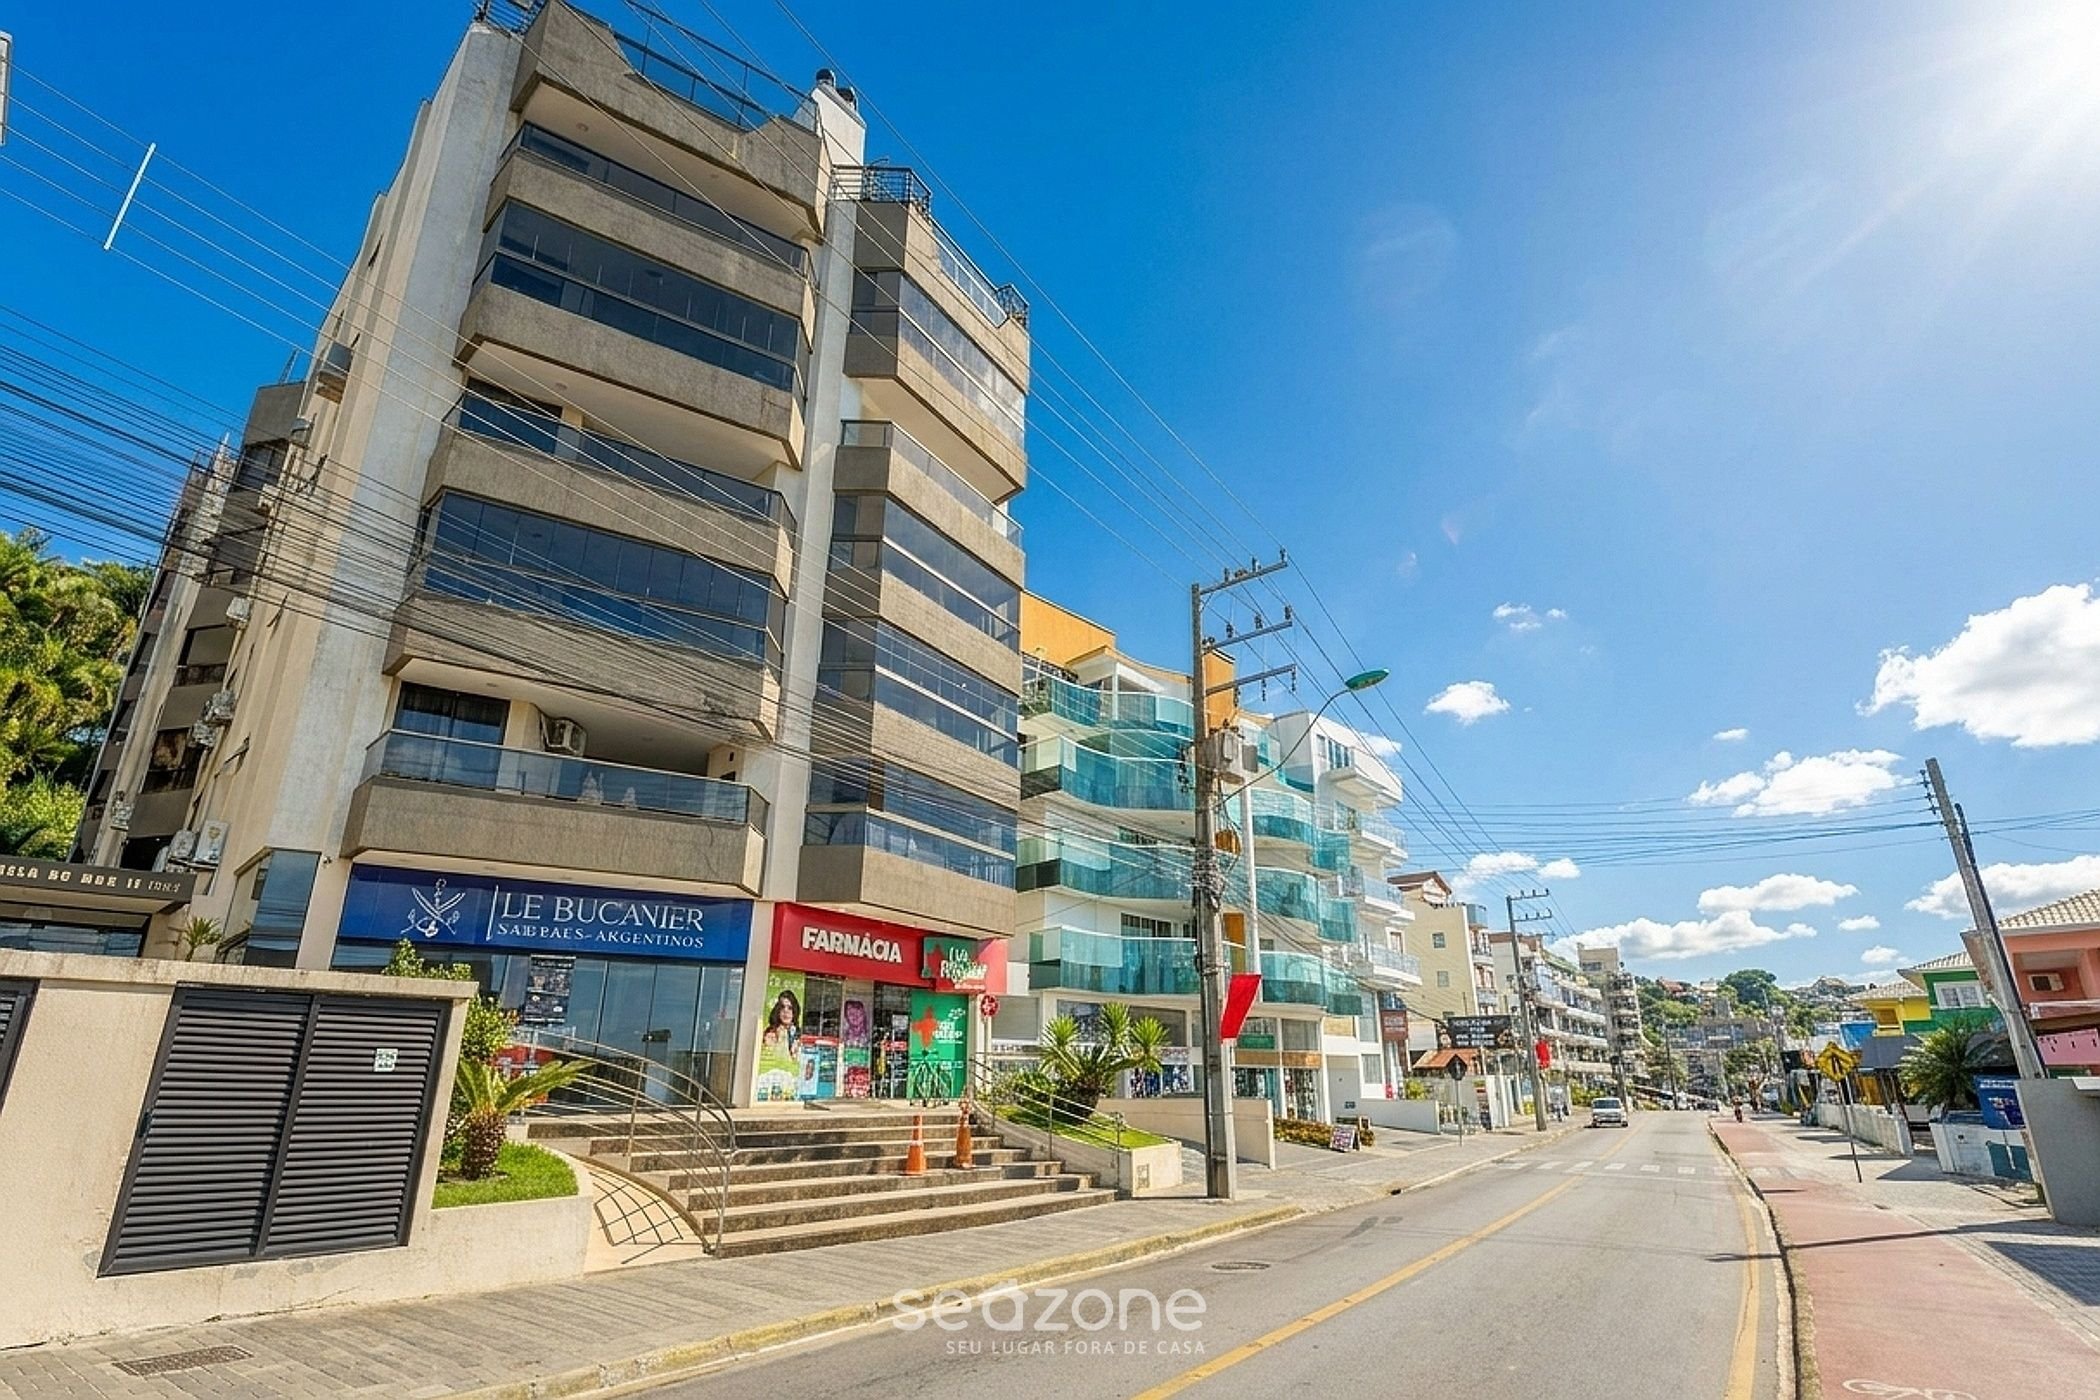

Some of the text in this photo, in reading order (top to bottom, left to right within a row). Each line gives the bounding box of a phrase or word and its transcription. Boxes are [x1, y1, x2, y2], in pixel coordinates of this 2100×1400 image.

[502, 892, 704, 931] LE BUCANIER
[802, 926, 902, 963] FARMÁCIA
